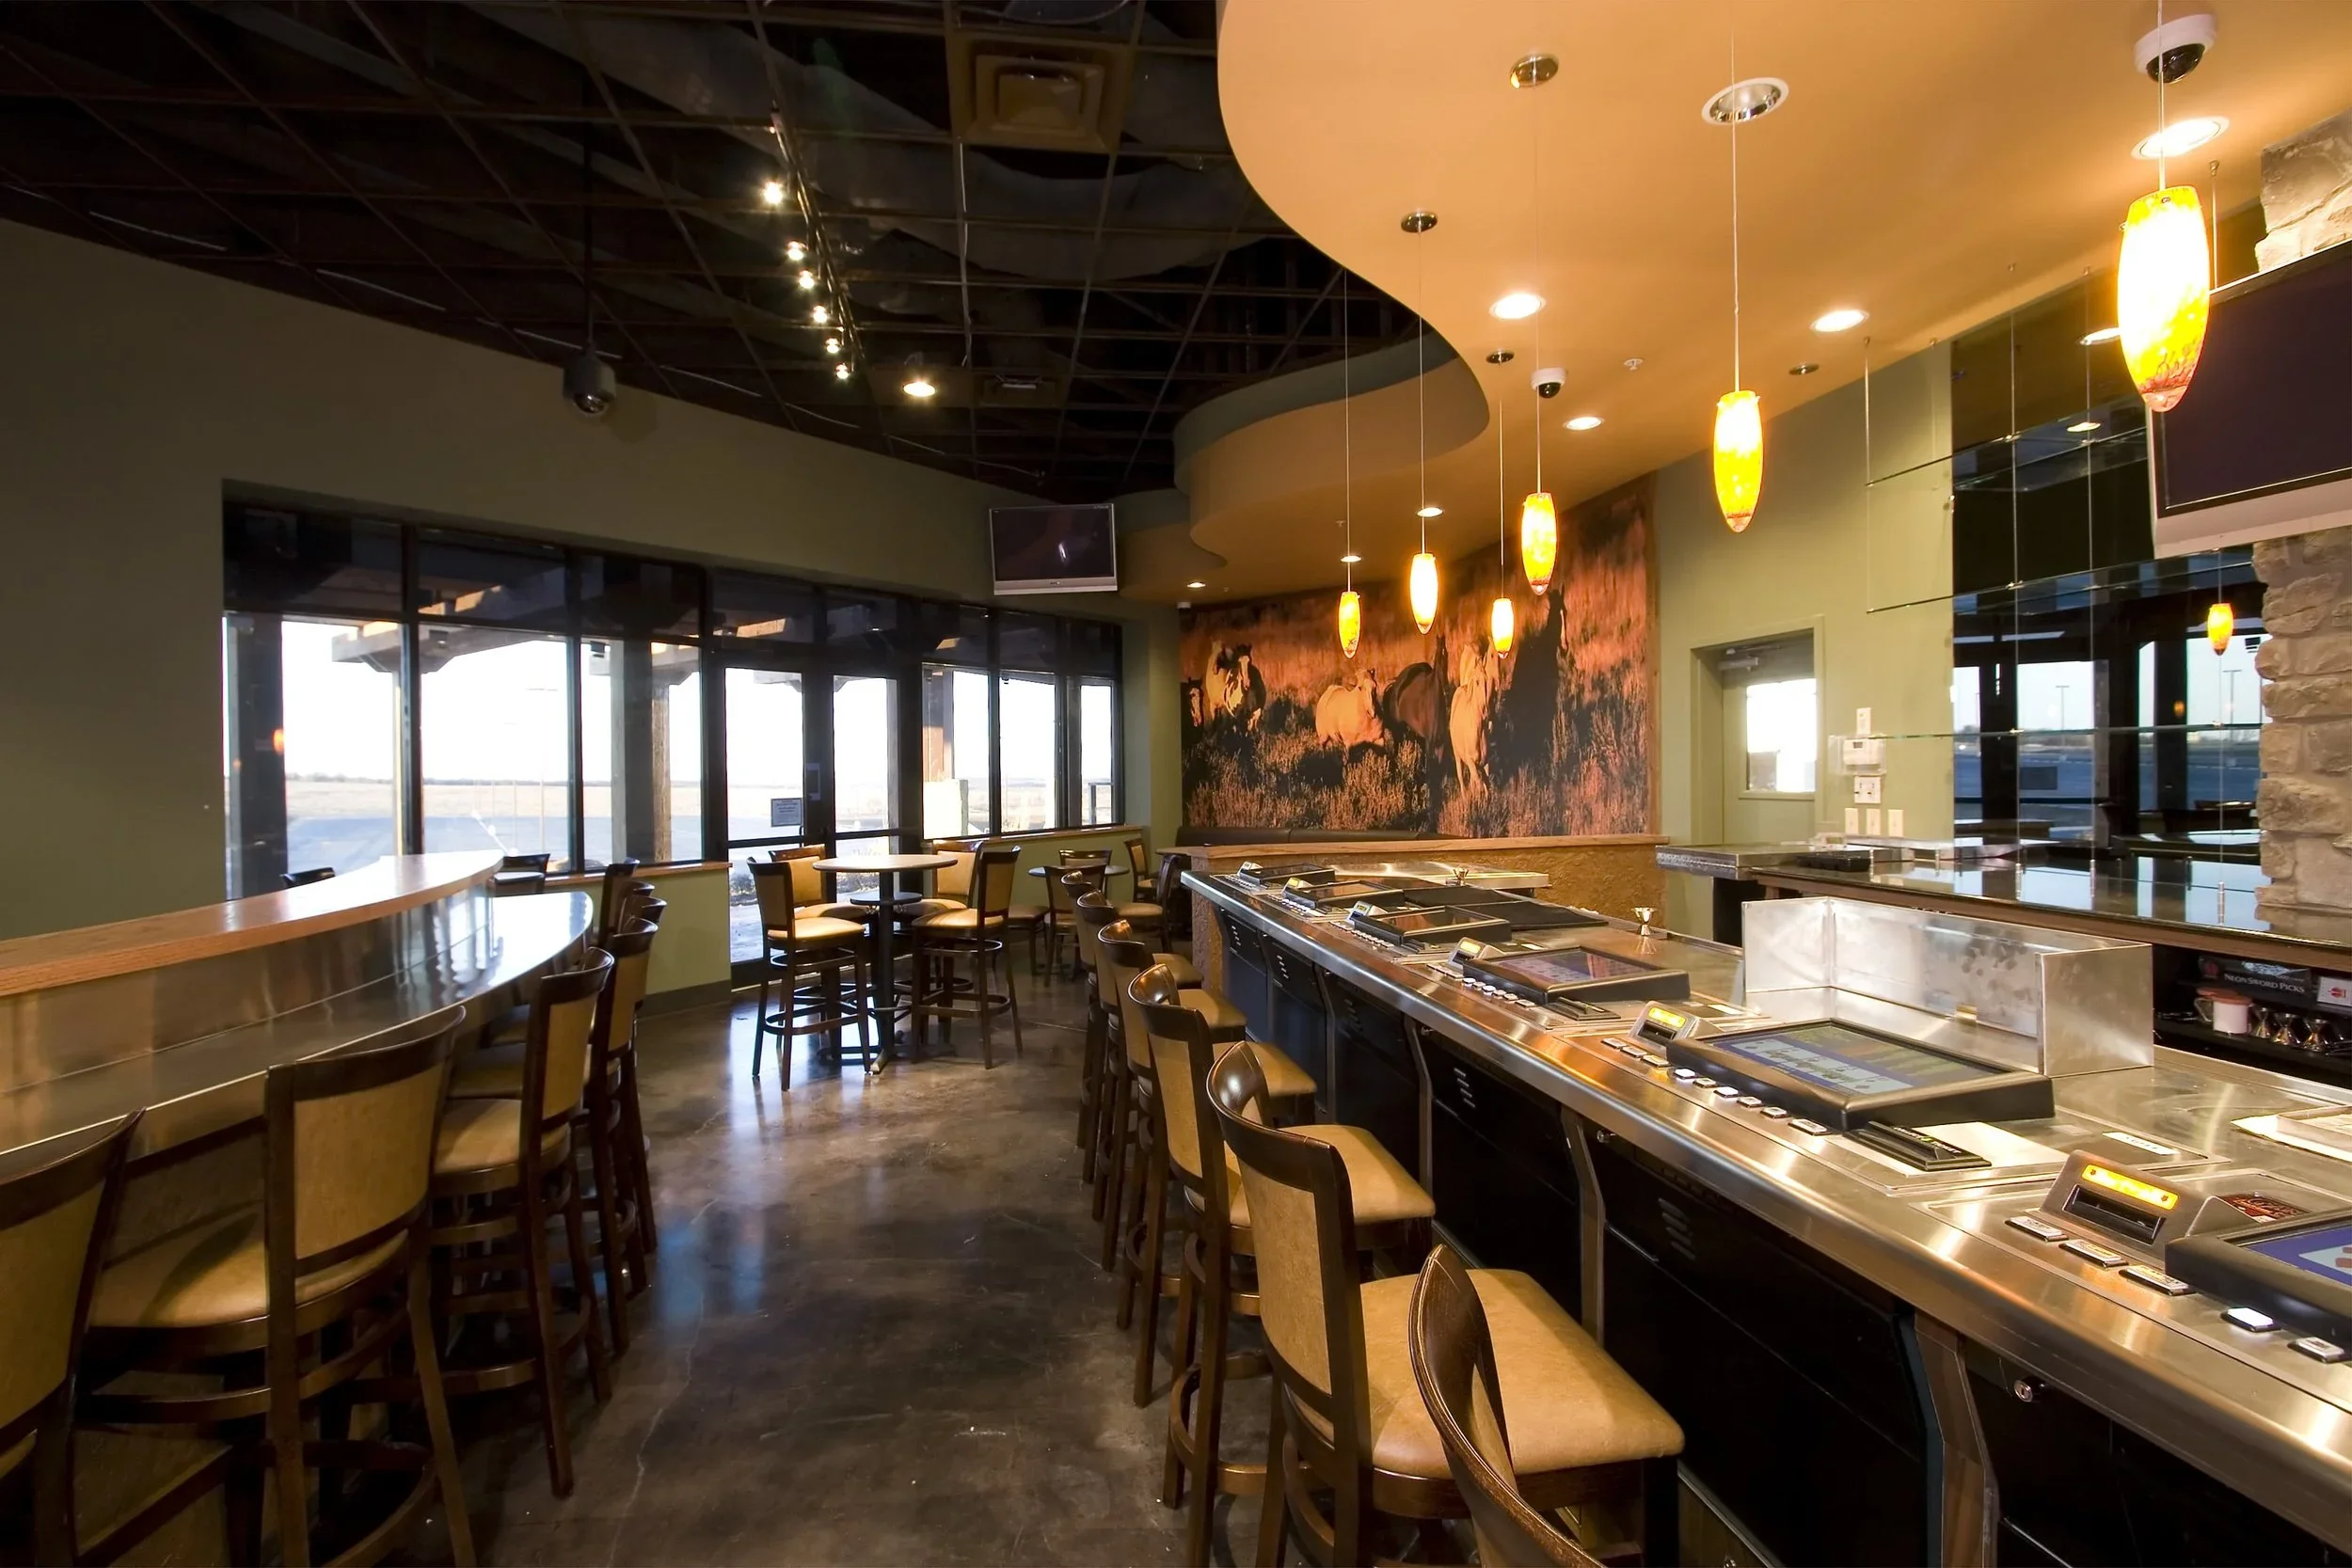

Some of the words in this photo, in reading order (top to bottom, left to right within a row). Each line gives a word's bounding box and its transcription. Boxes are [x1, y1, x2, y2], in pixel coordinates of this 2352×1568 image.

[2224, 974, 2248, 983] NEON
[2247, 977, 2279, 989] SWORD
[2280, 982, 2305, 993] PICKS
